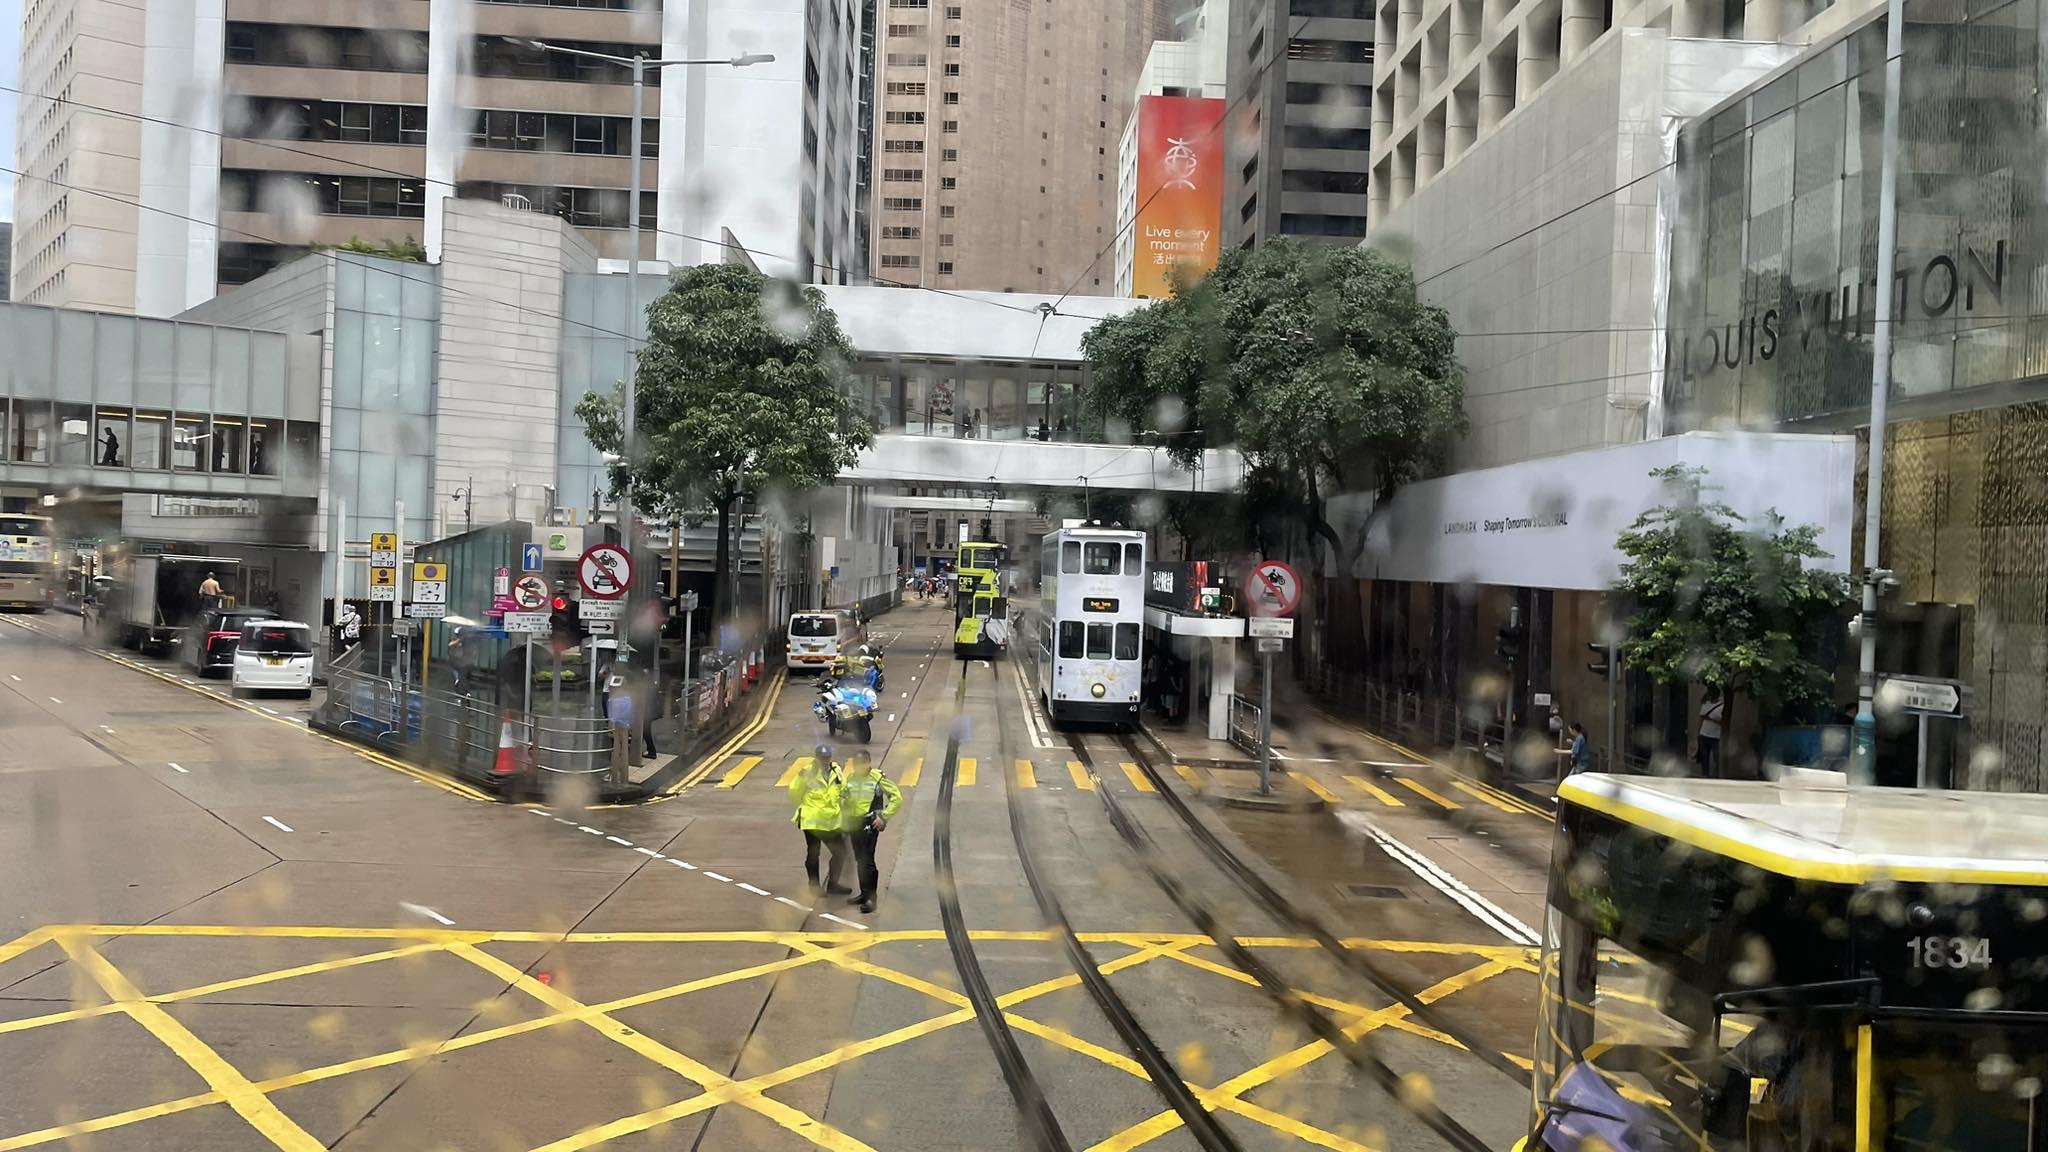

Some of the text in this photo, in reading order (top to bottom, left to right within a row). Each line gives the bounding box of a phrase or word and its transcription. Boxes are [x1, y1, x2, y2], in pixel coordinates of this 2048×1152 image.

[1145, 225, 1210, 241] Live eery
[1682, 309, 1778, 382] LOUIS
[1484, 519, 1505, 533] Shaping
[1906, 936, 1993, 969] 1834
